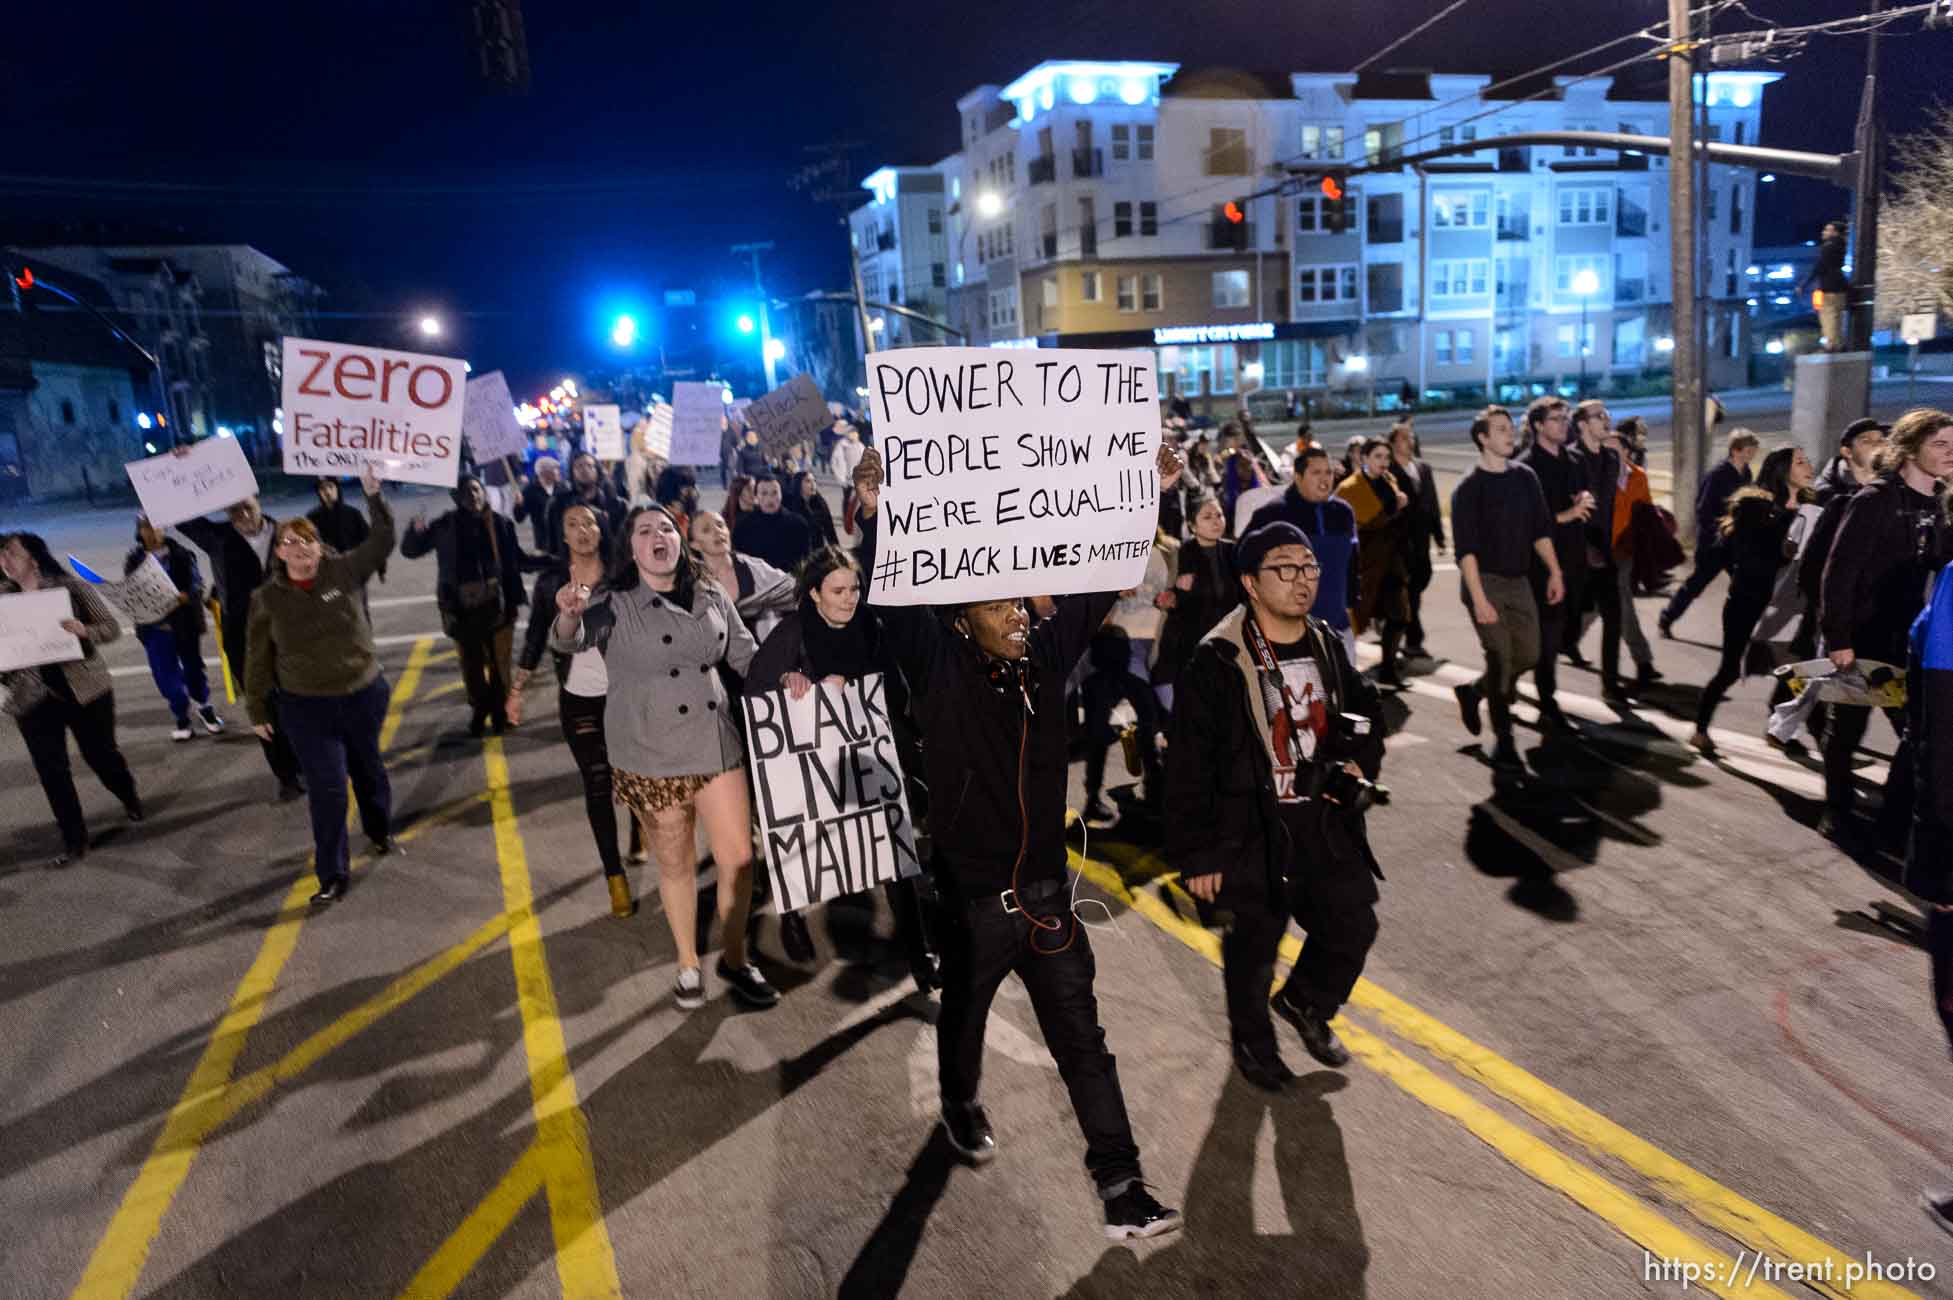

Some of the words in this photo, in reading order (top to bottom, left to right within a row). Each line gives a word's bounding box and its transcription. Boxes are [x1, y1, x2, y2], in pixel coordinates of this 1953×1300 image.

[299, 350, 453, 410] zero
[877, 360, 1023, 422] POWER
[1036, 362, 1082, 406] TO
[1097, 363, 1150, 405] THE
[294, 413, 452, 459] Fatalities
[884, 434, 1000, 487] PEOPLE
[1017, 433, 1091, 468] SHOW
[1107, 432, 1149, 457] ME
[885, 496, 981, 537] WE'RE
[996, 469, 1155, 526] EQUAL!!!!
[873, 547, 1001, 592] #BLACK
[1013, 543, 1081, 571] LIVES
[1087, 539, 1150, 563] MATTER
[746, 673, 891, 760] BLACK
[757, 735, 902, 829] LIVES
